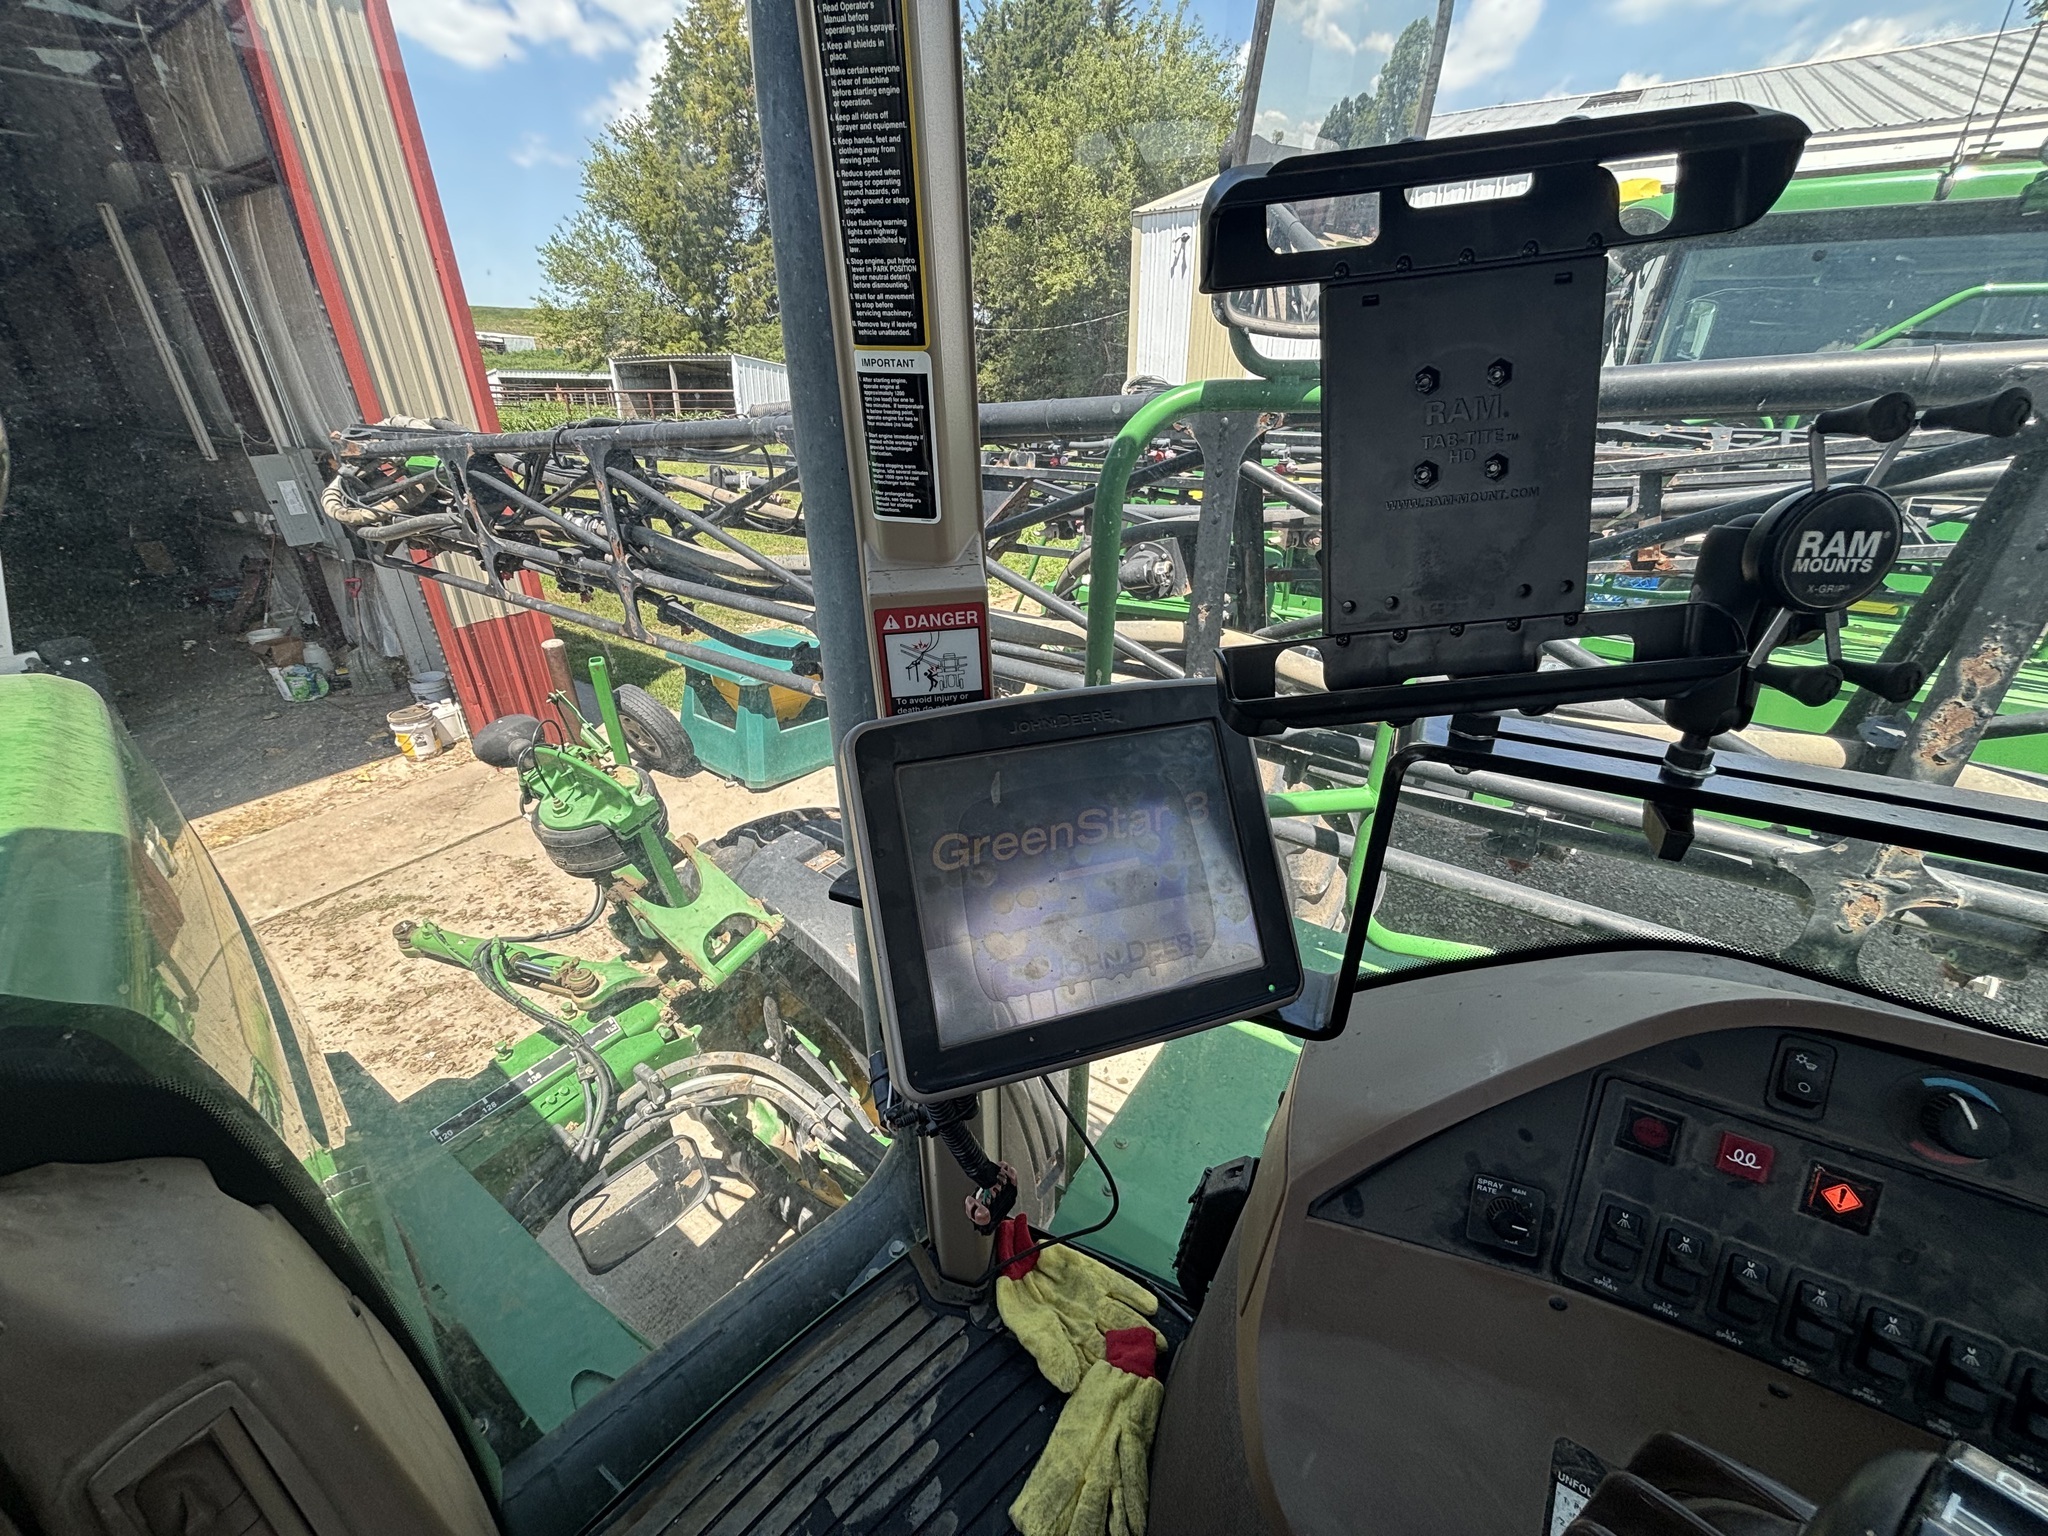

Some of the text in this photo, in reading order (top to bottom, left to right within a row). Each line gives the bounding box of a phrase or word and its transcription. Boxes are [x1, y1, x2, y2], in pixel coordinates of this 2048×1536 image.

[823, 3, 838, 12] Read
[840, 2, 874, 12] Operator's
[824, 13, 869, 23] Manual before
[825, 24, 897, 36] operating this sprayer.
[827, 41, 843, 51] Keep
[853, 39, 876, 48] shields
[830, 53, 848, 62] place.
[830, 68, 845, 76] Make
[847, 66, 869, 74] certain
[870, 66, 900, 74] everyone
[862, 76, 889, 84] machine
[853, 87, 877, 96] starting
[878, 86, 900, 96] engine
[841, 98, 872, 108] operation.
[835, 114, 850, 122] Keep
[836, 124, 858, 132] sprayer
[873, 121, 907, 130] equipment.
[838, 137, 852, 145] Keep
[840, 156, 880, 165] moving parts.
[864, 169, 882, 178] speed
[842, 179, 863, 187] turning
[872, 179, 900, 187] operating
[862, 197, 883, 206] ground
[883, 218, 907, 227] warning
[868, 237, 898, 245] prohibited
[899, 236, 906, 245] by
[865, 258, 886, 266] engine,
[862, 359, 914, 367] IMPORTANT
[1449, 448, 1475, 463] HD
[1386, 487, 1539, 511] WWW.RAM-MOUNT.COM
[1792, 558, 1873, 572] MOUNTS
[905, 611, 978, 628] DANGER
[910, 696, 932, 704] avoid
[935, 694, 957, 703] injury
[898, 706, 920, 714] death
[1009, 709, 1112, 734] JOHN DEERE
[932, 804, 1170, 870] GreenStar
[527, 1073, 542, 1084] 136
[482, 1102, 497, 1113] 128
[438, 1130, 453, 1142] 120
[1478, 1178, 1503, 1189] SPRAY
[1477, 1184, 1497, 1194] RATE
[1593, 1278, 1617, 1292] SPRAY
[1653, 1303, 1679, 1318] SPRAY
[1716, 1330, 1743, 1345] SPRAY
[1558, 1471, 1592, 1497] UNFOL
